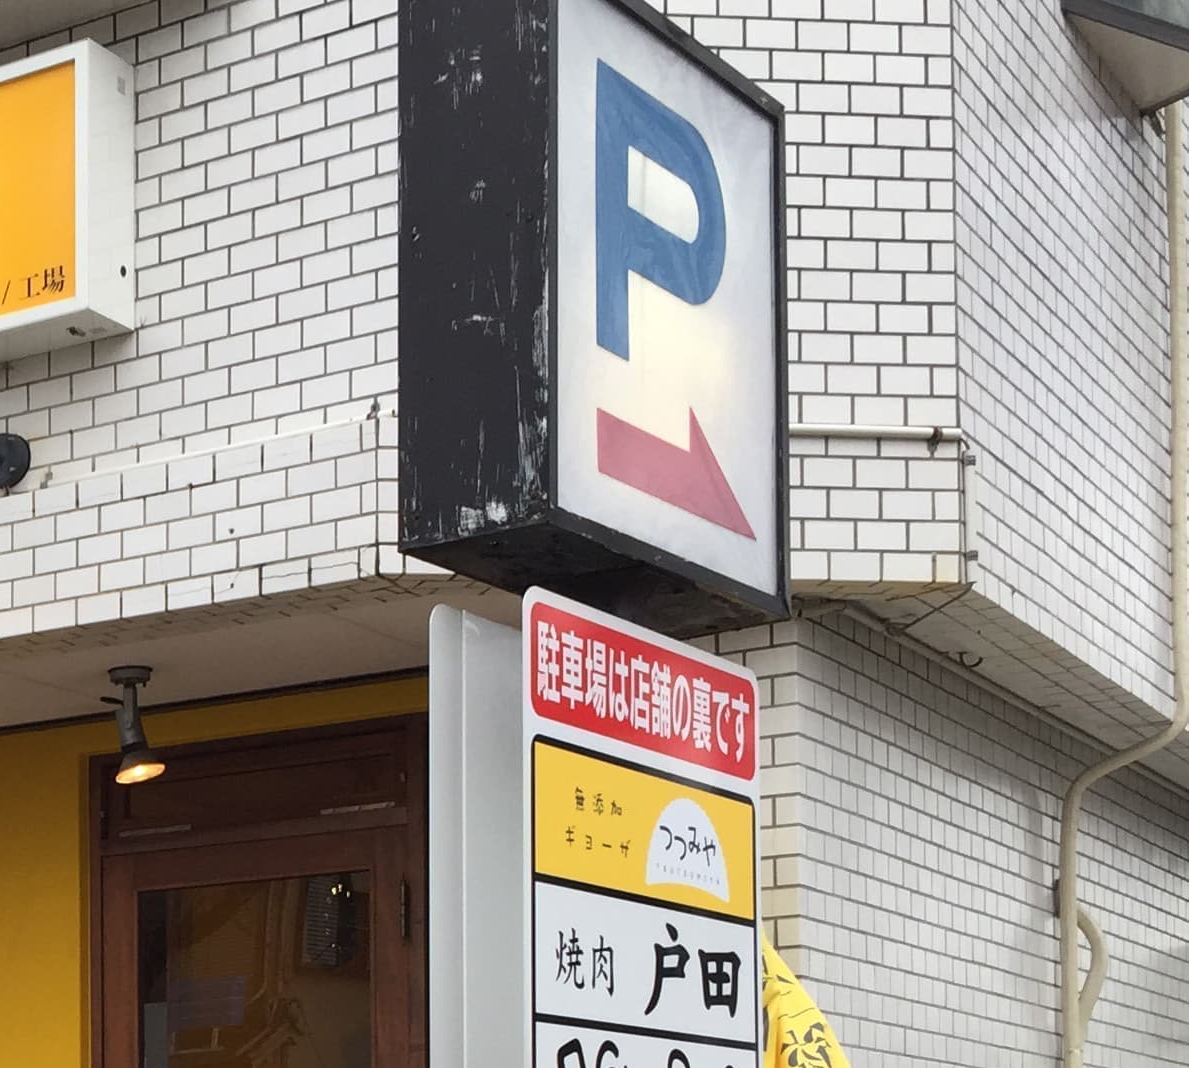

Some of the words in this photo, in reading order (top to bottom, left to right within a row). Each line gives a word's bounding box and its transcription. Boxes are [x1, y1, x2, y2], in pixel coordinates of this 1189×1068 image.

[595, 57, 727, 361] P
[536, 620, 750, 763] 駐車場は店舗の裏です
[574, 786, 623, 816] 無添加
[565, 825, 631, 859] ギョーザ
[659, 825, 716, 867] つつみや
[555, 928, 615, 998] 焼肉
